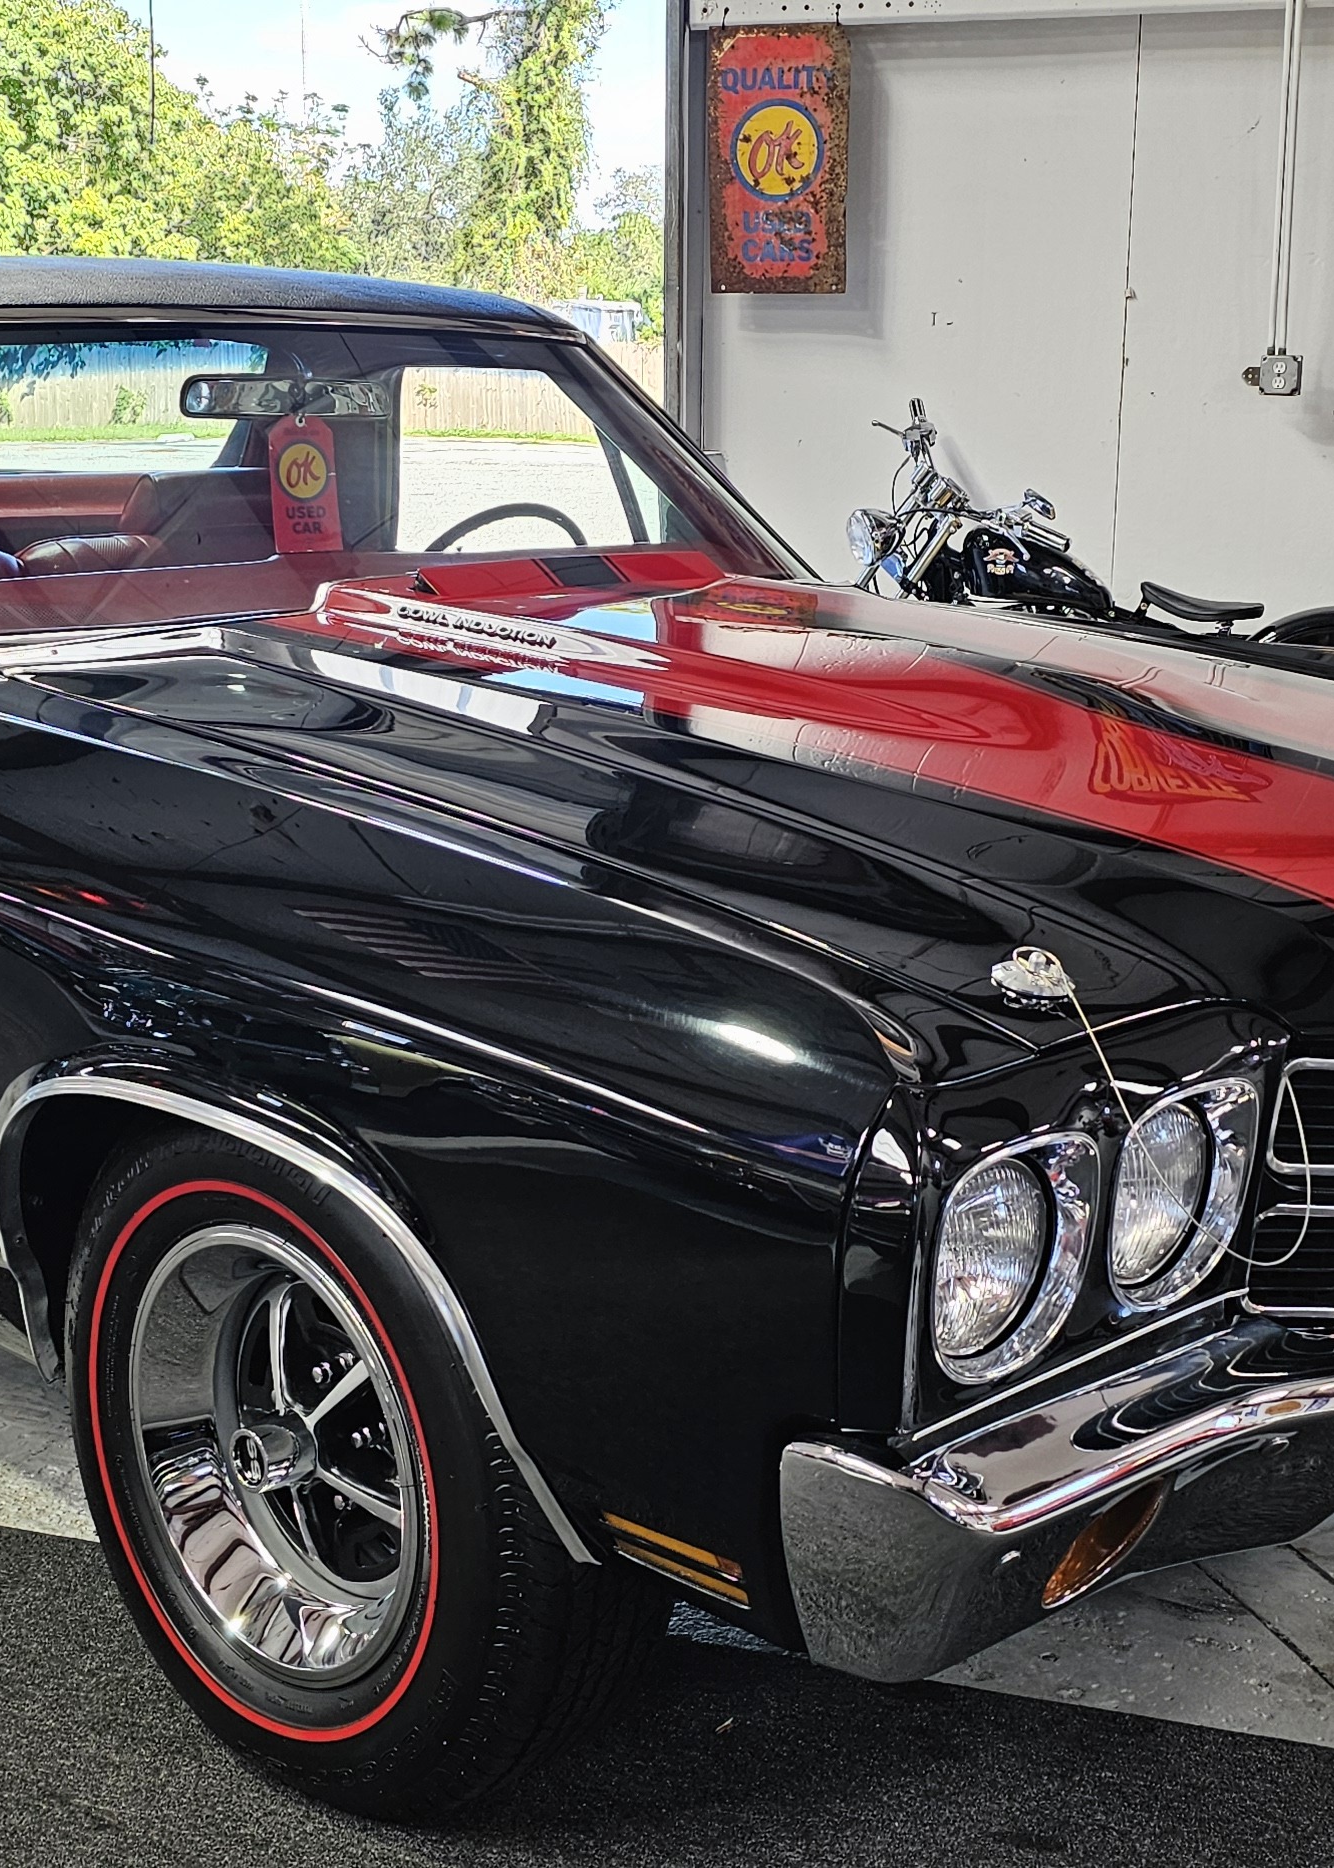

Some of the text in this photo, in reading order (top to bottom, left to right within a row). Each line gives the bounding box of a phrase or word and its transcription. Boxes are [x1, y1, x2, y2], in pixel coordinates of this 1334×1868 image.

[720, 66, 836, 94] QUALITY
[748, 120, 805, 179] OK
[742, 210, 812, 235] USED
[741, 238, 815, 263] CARS
[286, 450, 321, 488] OK
[286, 505, 326, 520] USED
[292, 521, 323, 534] CAR
[396, 604, 558, 649] COWL INDUCTION
